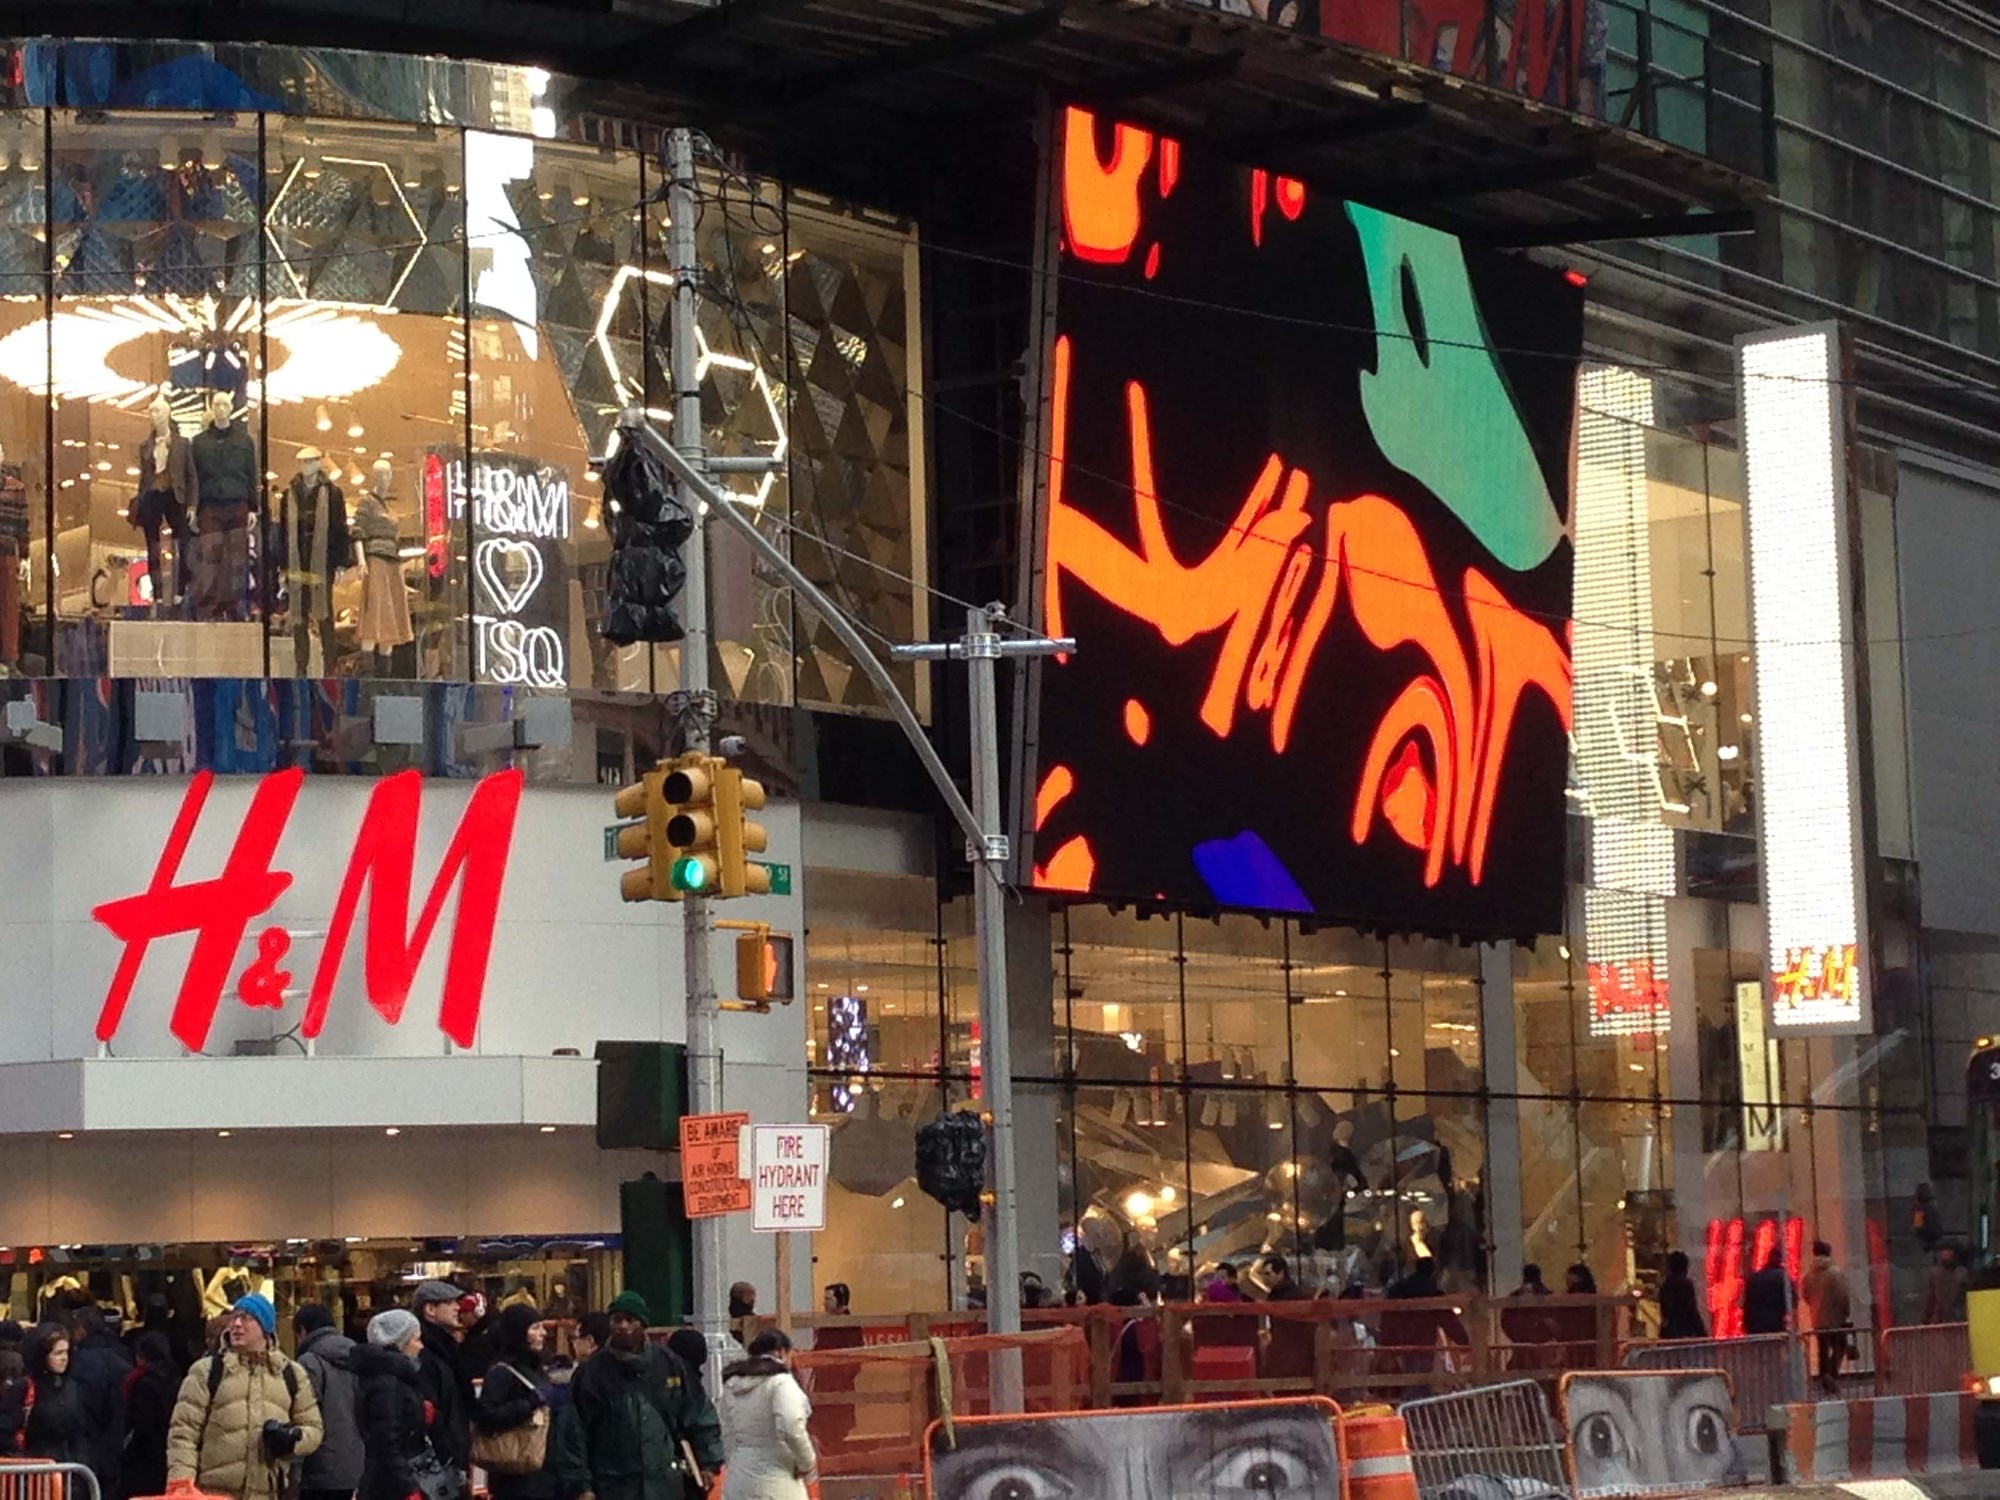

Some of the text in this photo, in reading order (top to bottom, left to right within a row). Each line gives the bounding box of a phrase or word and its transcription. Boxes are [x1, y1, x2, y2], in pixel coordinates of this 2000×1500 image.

[472, 614, 567, 687] TSQ
[91, 767, 524, 1053] H&M
[687, 1123, 701, 1141] BE
[777, 1135, 803, 1158] FIRE
[759, 1164, 819, 1188] HYDRANT
[773, 1194, 805, 1219] HERE
